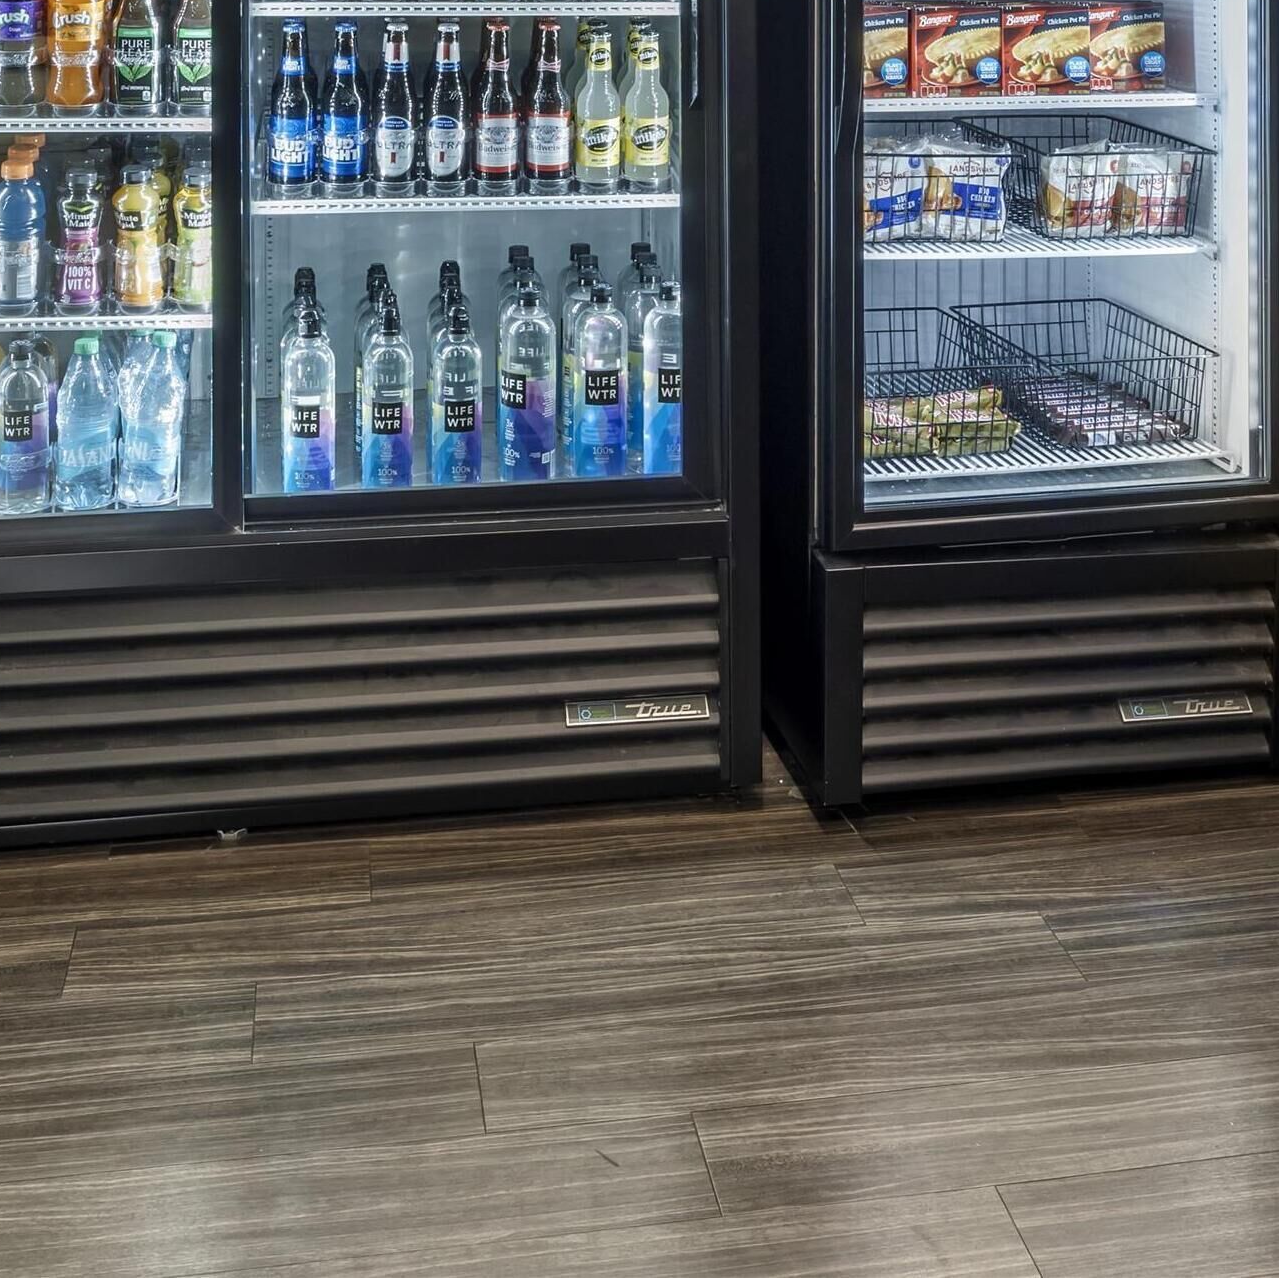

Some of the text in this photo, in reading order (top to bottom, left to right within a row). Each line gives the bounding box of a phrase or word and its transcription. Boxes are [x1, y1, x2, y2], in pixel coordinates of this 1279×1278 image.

[122, 40, 150, 48] PURE
[68, 265, 92, 278] 100%
[67, 278, 82, 290] VIT
[588, 375, 617, 387] LIFE
[587, 389, 617, 400] WTR
[291, 410, 318, 420] LIFE
[374, 407, 401, 418] LIFE
[447, 405, 473, 415] LIFE
[5, 414, 30, 425] LIFE
[373, 419, 401, 429] WTR
[447, 418, 473, 428] WTR
[4, 427, 31, 437] WTR
[291, 423, 318, 433] WTR
